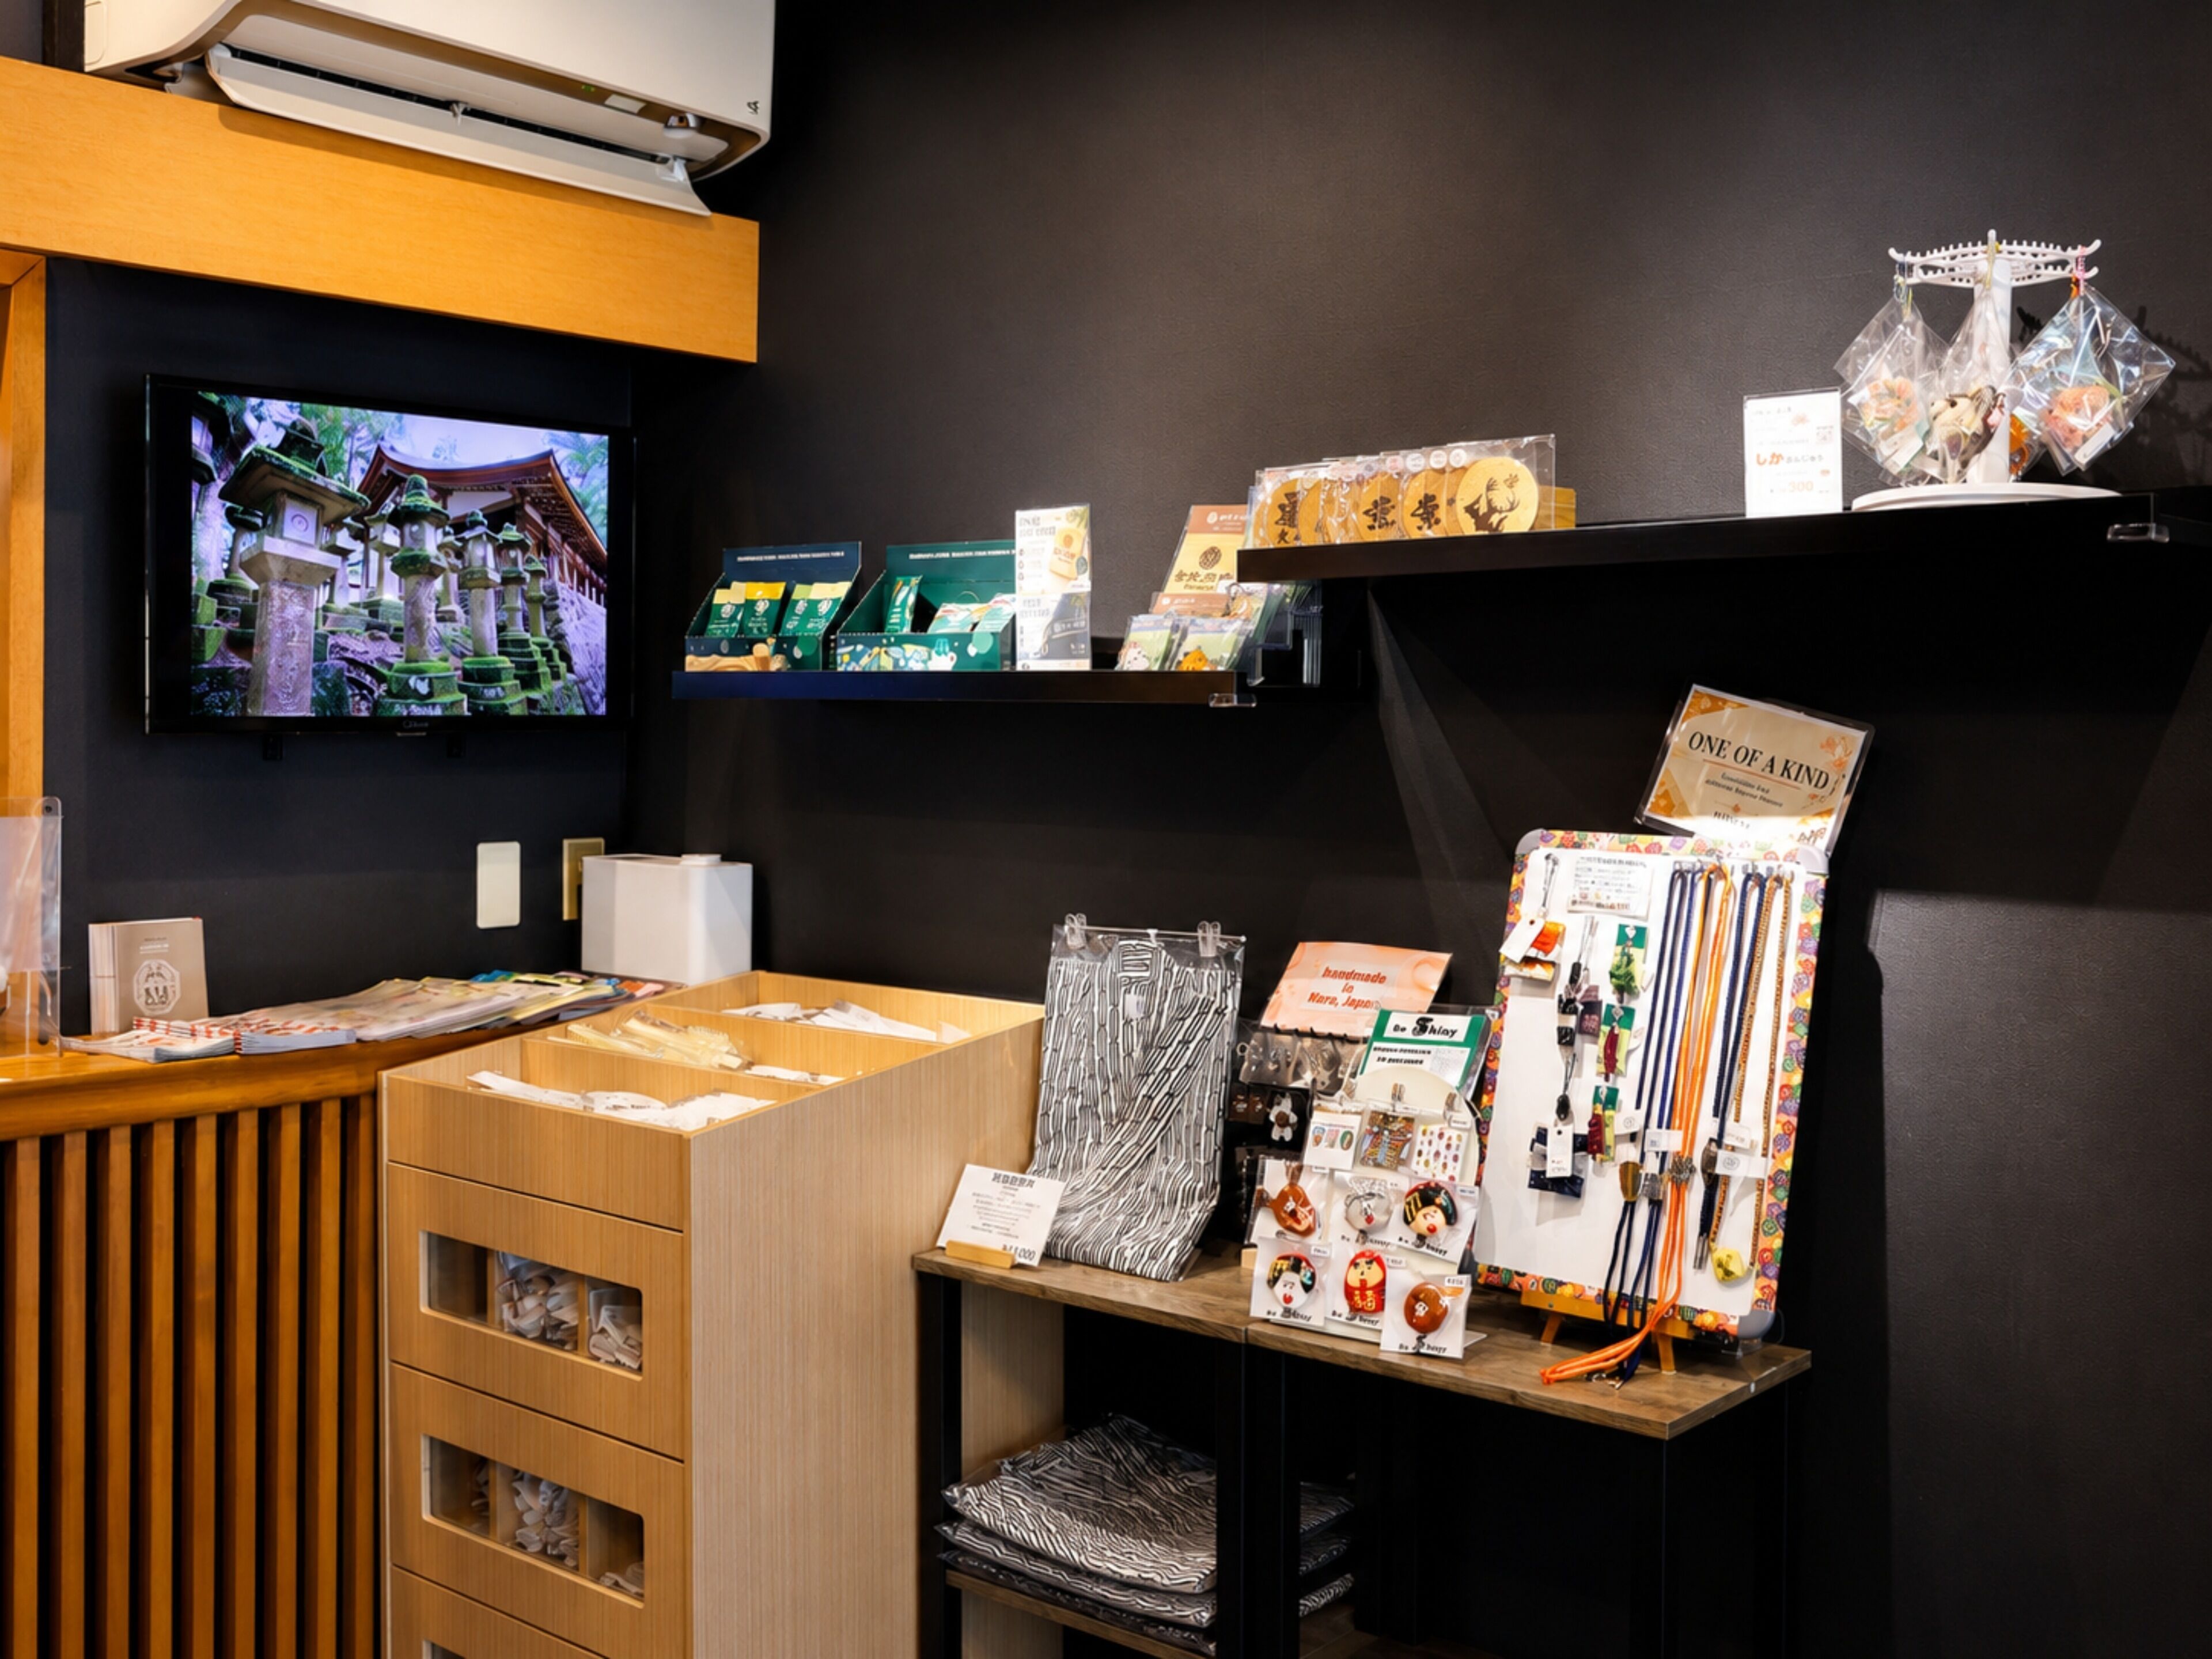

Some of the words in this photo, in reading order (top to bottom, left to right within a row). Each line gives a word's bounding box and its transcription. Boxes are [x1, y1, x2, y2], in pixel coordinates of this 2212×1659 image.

[1688, 731, 1732, 759] ONE
[1733, 745, 1763, 767] OF
[1761, 756, 1776, 774] A
[1780, 759, 1830, 790] KIND
[1321, 966, 1388, 984] handmade
[1308, 991, 1339, 1007] Nara,
